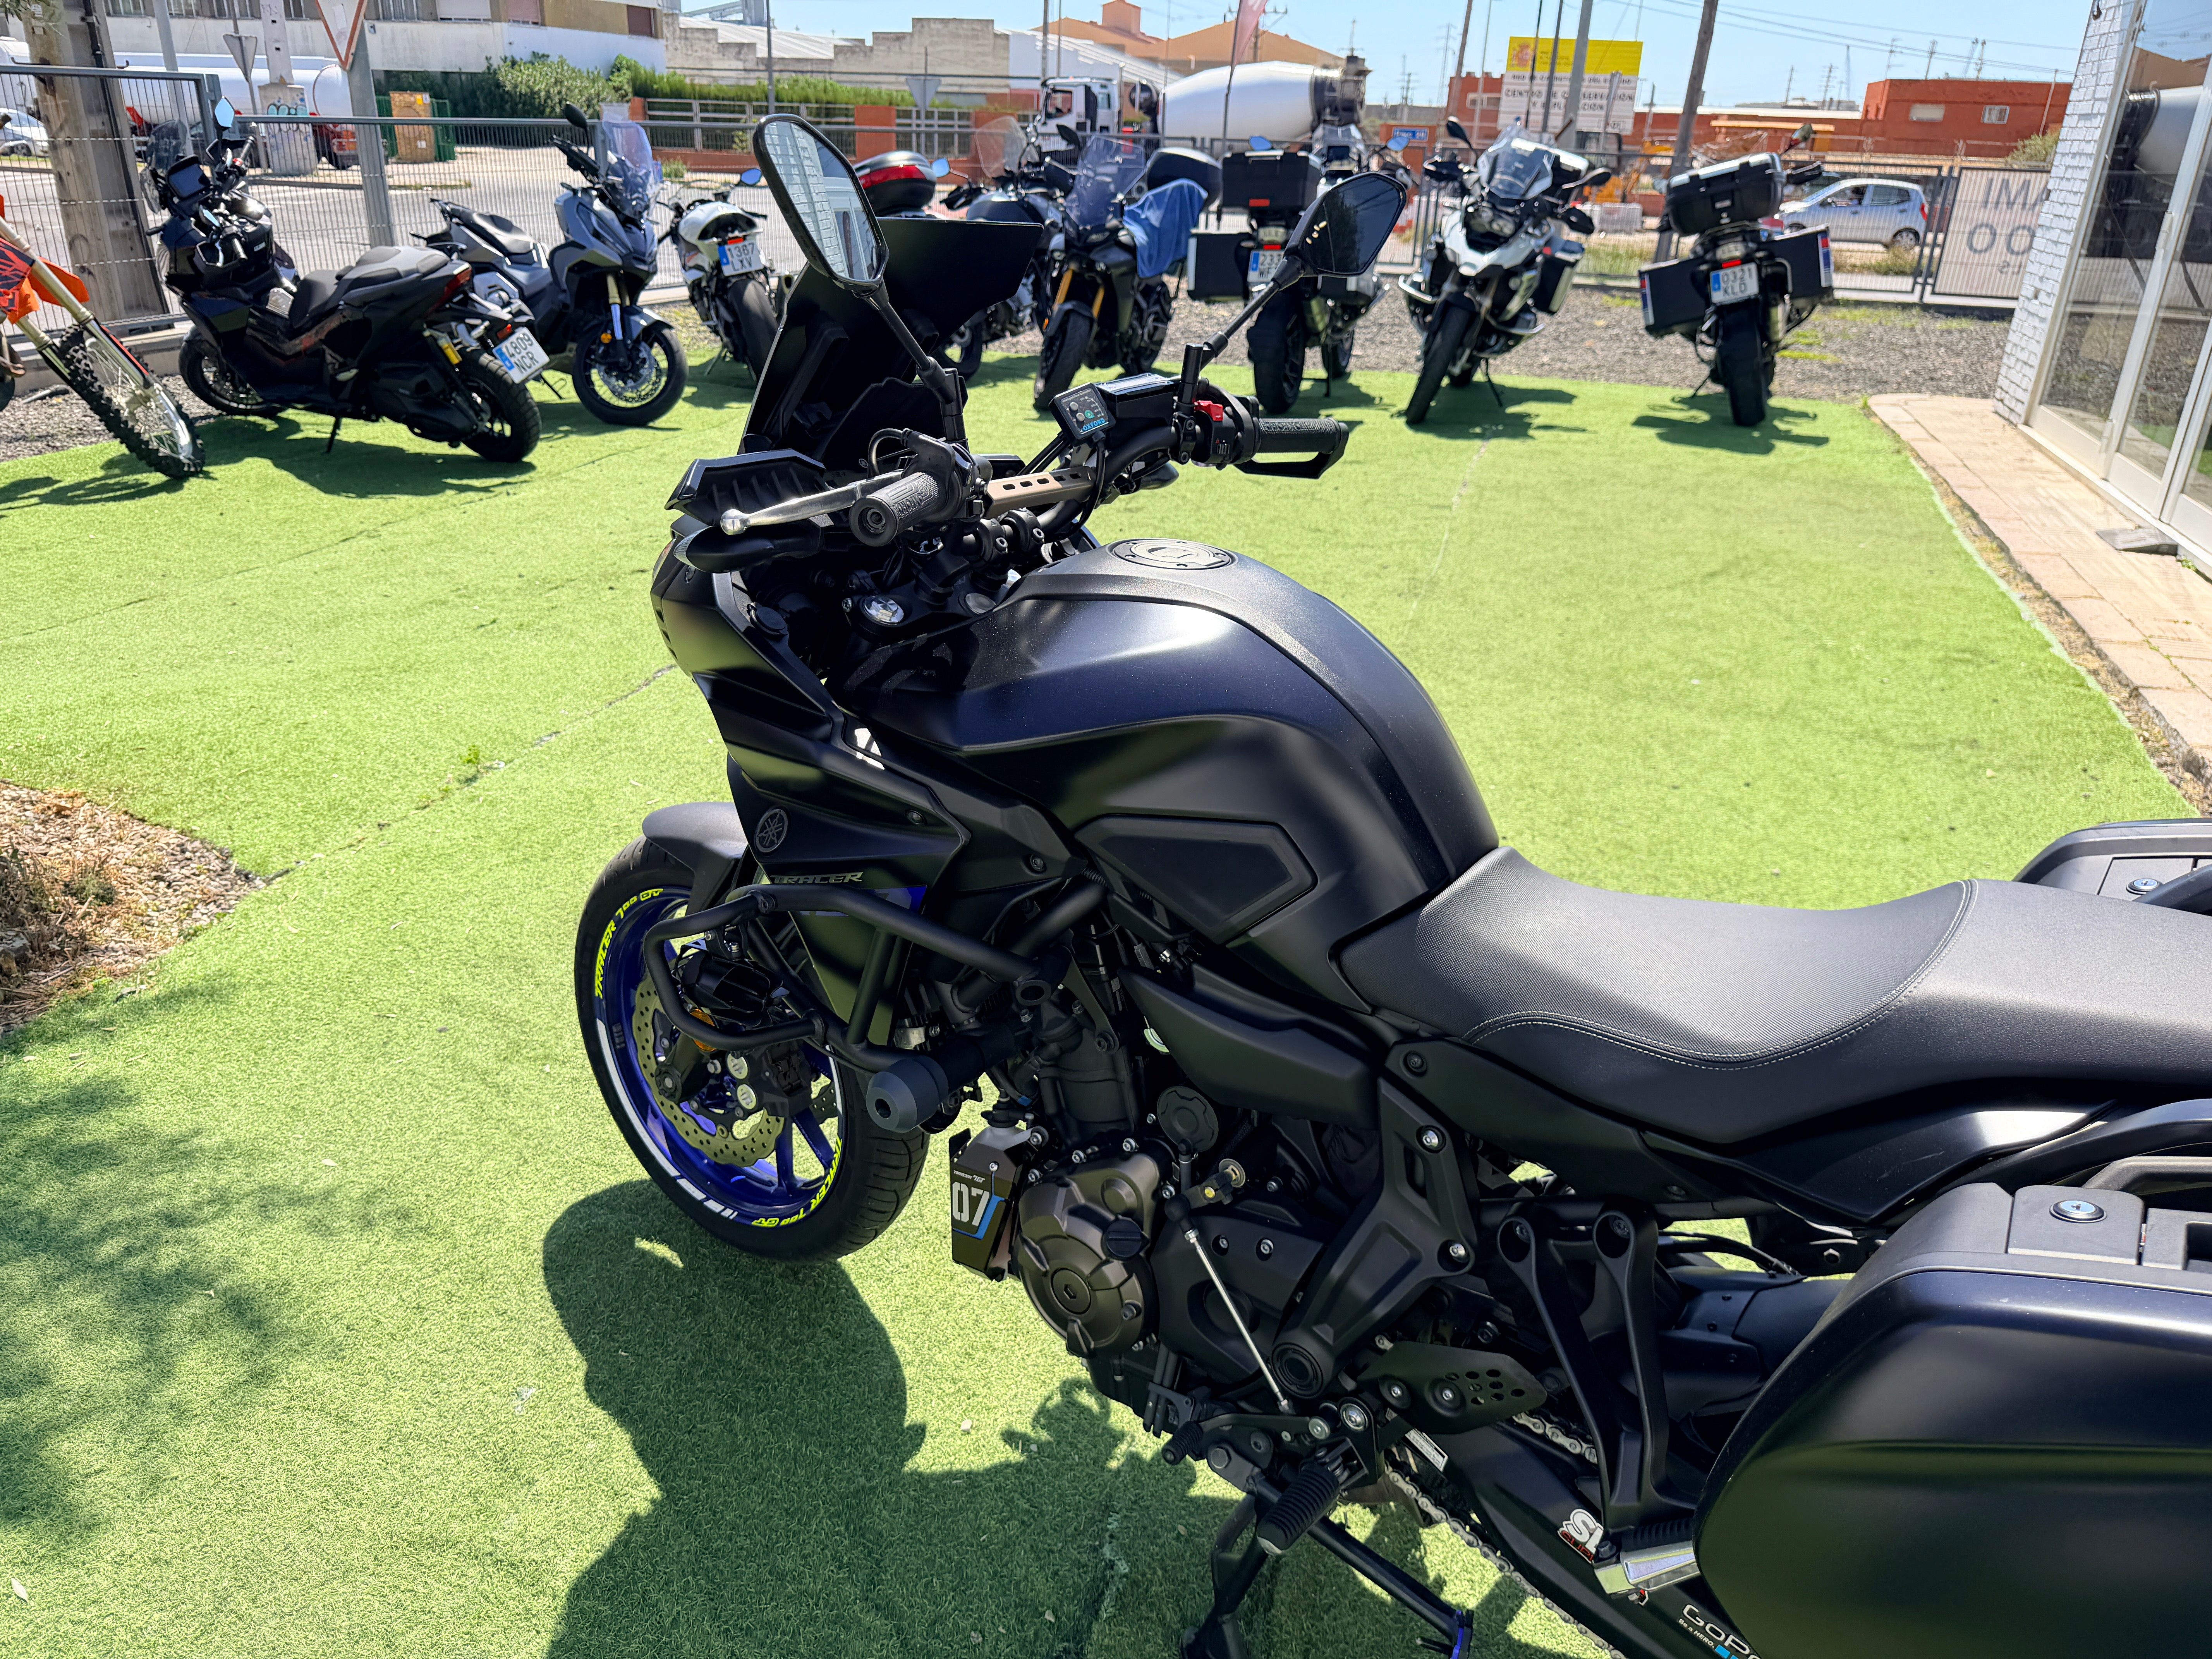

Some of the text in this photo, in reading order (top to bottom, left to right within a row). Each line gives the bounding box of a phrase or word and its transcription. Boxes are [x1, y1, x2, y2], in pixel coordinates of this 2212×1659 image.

[728, 242, 754, 258] 1367
[731, 256, 752, 271] LXV
[1722, 267, 1752, 284] 0321
[505, 332, 534, 358] 4809
[514, 350, 539, 374] NCR
[1082, 418, 1106, 431] OXFORD
[771, 871, 864, 884] TRACER
[595, 919, 616, 999] TRACER
[616, 895, 637, 919] 700
[751, 1135, 842, 1228] TRACER 700 GT
[953, 1170, 972, 1179] TRACER
[952, 1182, 990, 1226] 07
[1678, 1618, 1688, 1628] Be
[1693, 1630, 1715, 1648] HERO.
